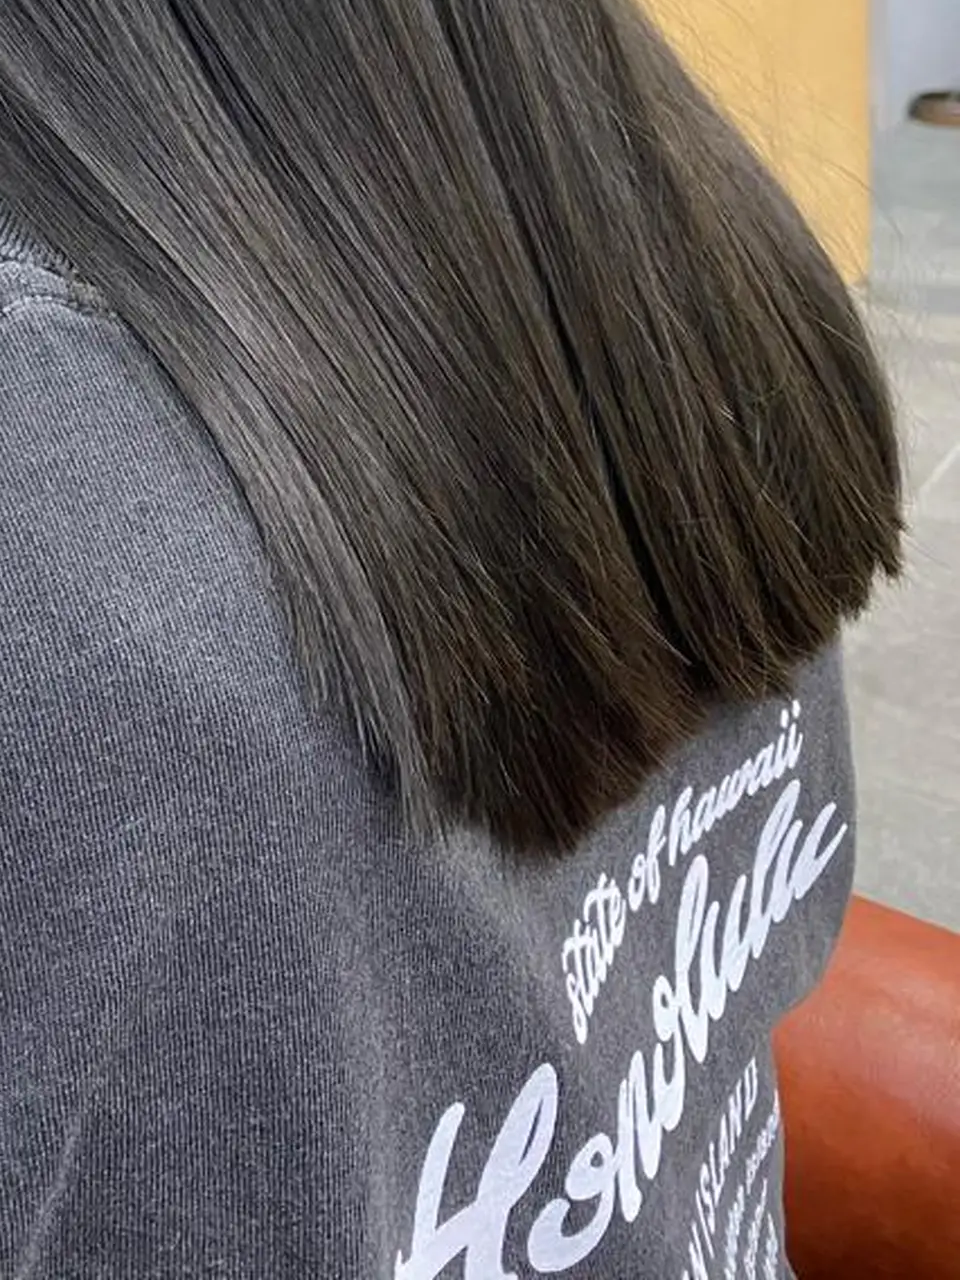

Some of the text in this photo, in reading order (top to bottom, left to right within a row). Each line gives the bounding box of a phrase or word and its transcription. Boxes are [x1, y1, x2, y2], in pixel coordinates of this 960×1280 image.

[628, 804, 667, 911] of
[668, 699, 804, 866] hawaii
[394, 779, 847, 1280] Honolulu
